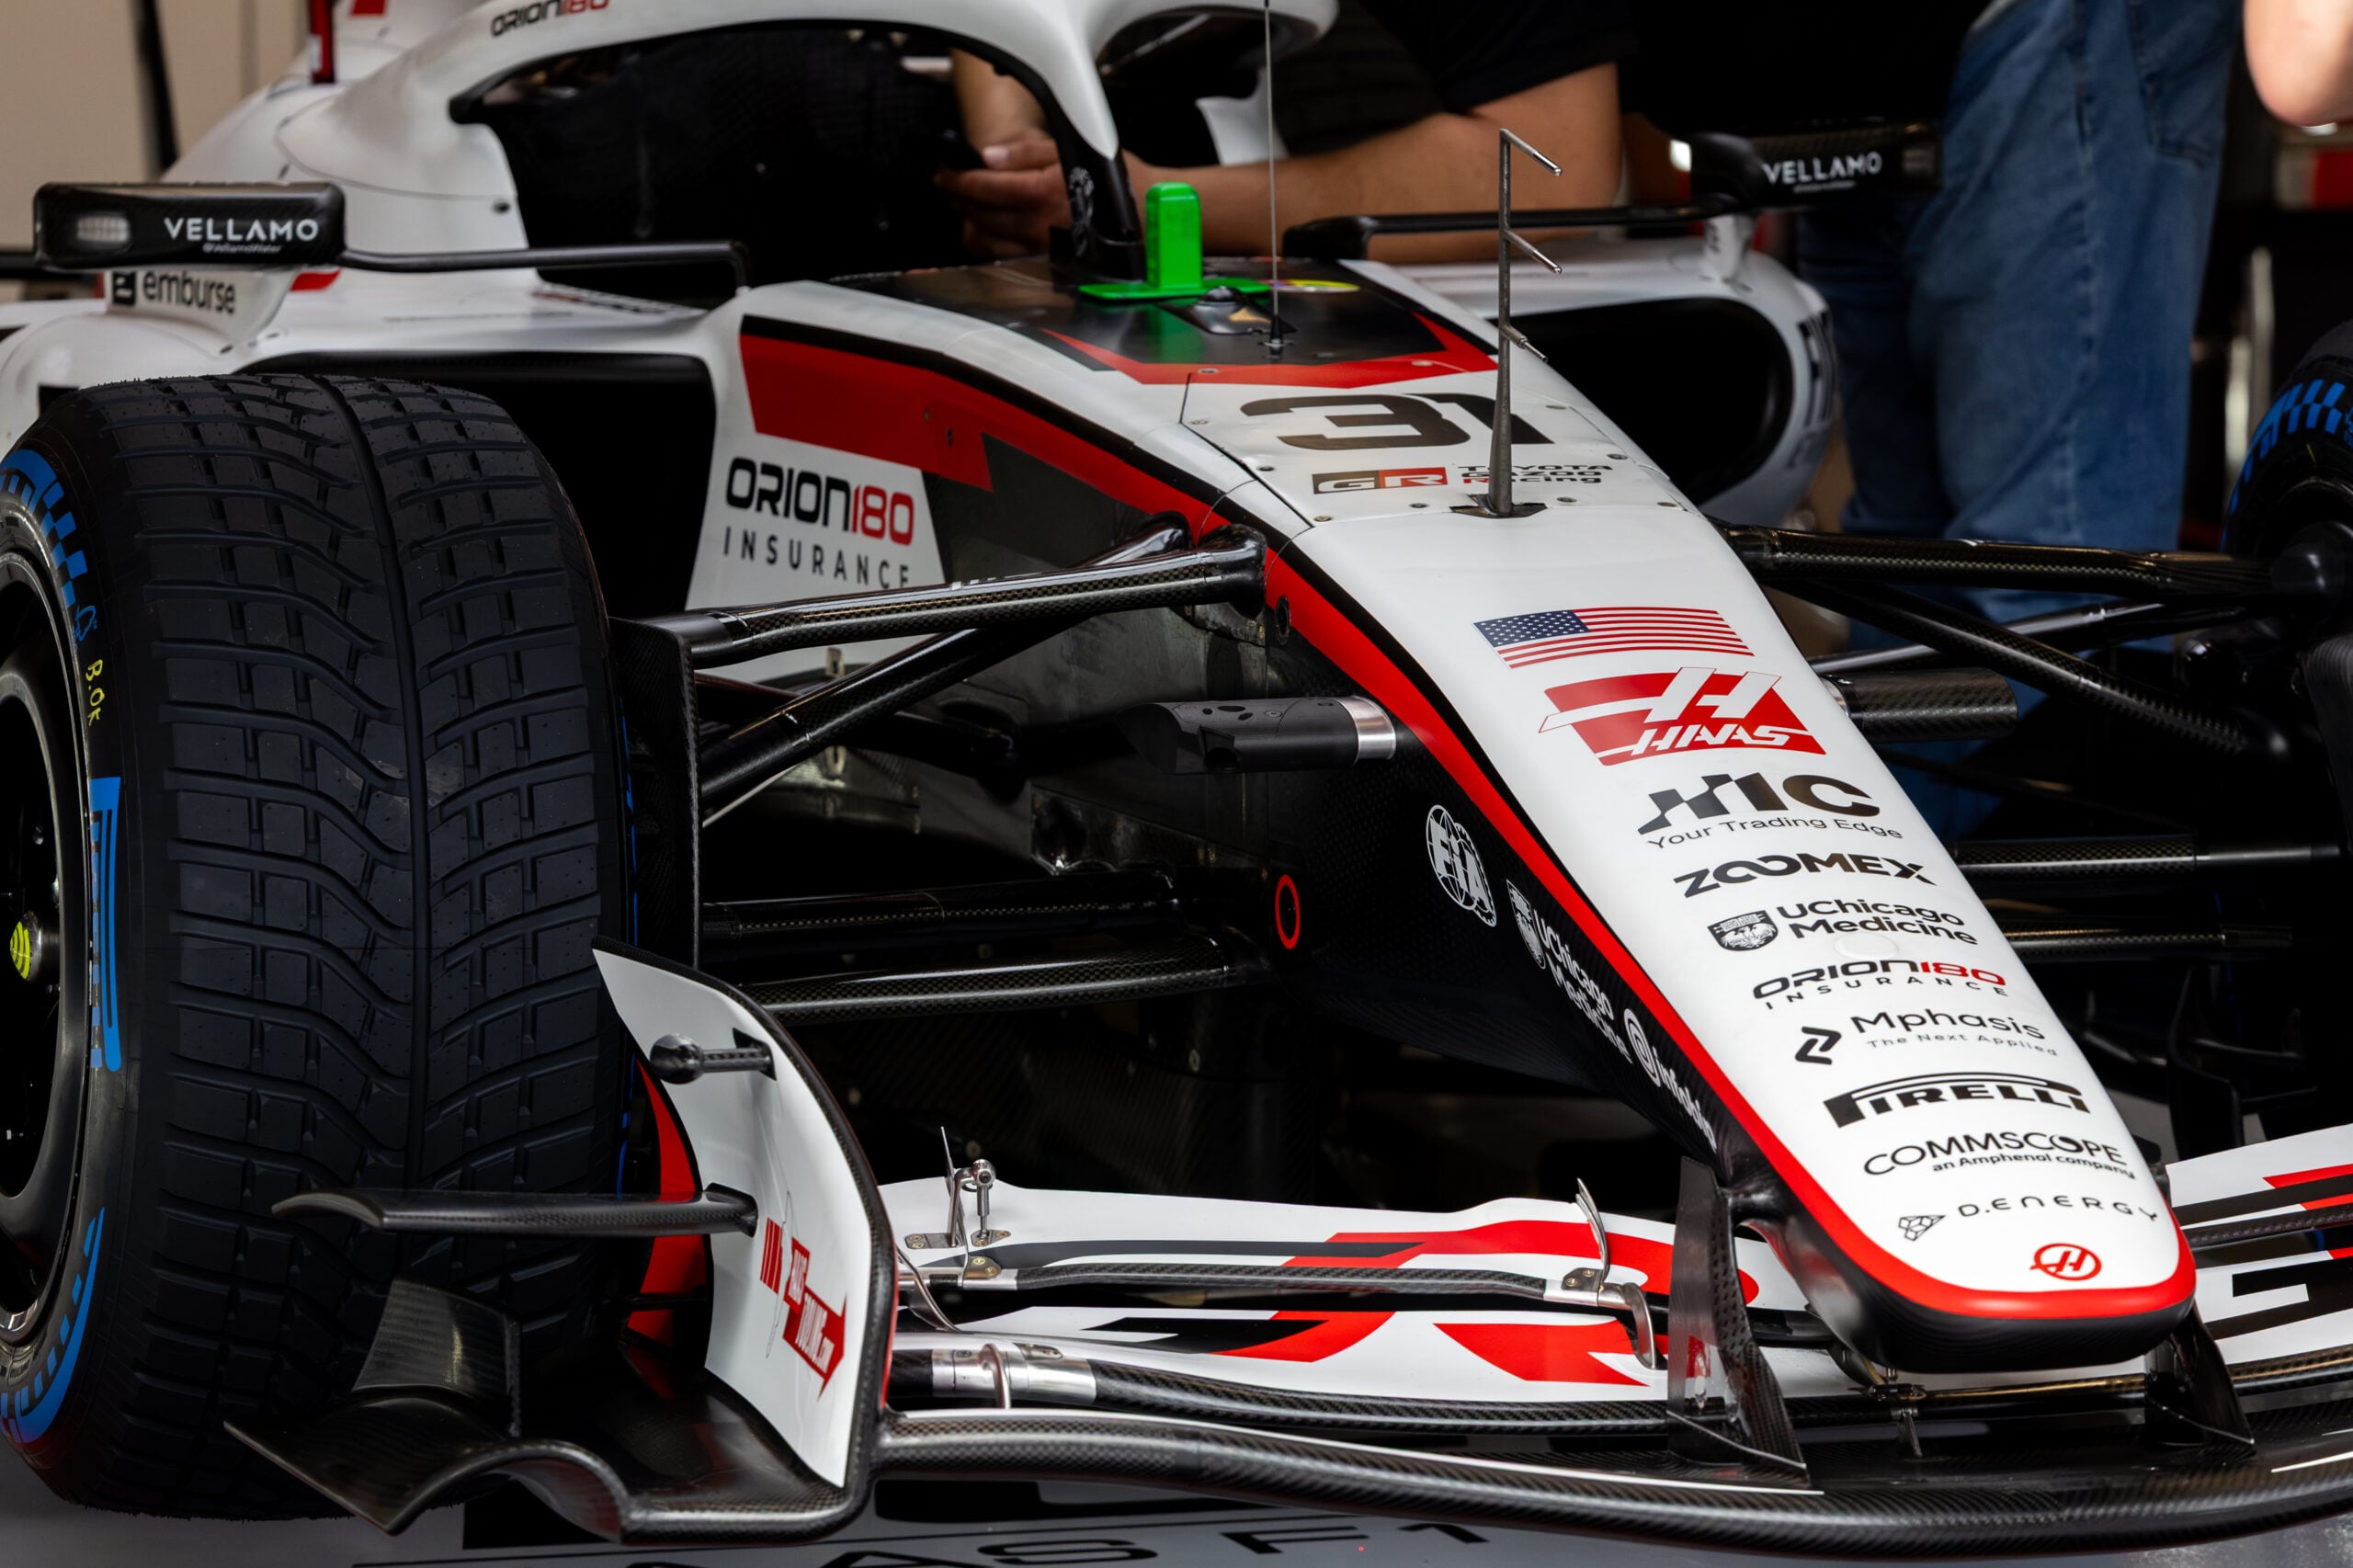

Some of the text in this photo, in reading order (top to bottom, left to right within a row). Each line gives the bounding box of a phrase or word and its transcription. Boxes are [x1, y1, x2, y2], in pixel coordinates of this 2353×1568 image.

[1762, 152, 1881, 185] VELLAMO
[164, 217, 319, 242] VELLAMO
[142, 270, 235, 314] emburse
[1240, 392, 1555, 450] 31
[1314, 470, 1447, 494] GR
[726, 457, 915, 546] ORION180
[1629, 723, 1807, 756] HAAS
[1647, 817, 1903, 849] Your Trading Edge
[1673, 853, 1938, 898] ZOOMEX
[1776, 898, 1965, 926] UChicago
[1789, 917, 1979, 946] Medicine
[1533, 908, 1614, 1021] UChicago
[1753, 959, 2006, 999] ORION180
[1766, 976, 2008, 1010] INSURANCE
[1850, 1008, 2046, 1040] Mphasis
[1867, 1032, 2059, 1056] The Next Applied
[1824, 1072, 2090, 1128] PIRELLI
[1864, 1131, 2127, 1176] COMMSCOPE
[1932, 1152, 2136, 1180] an Amphenol company
